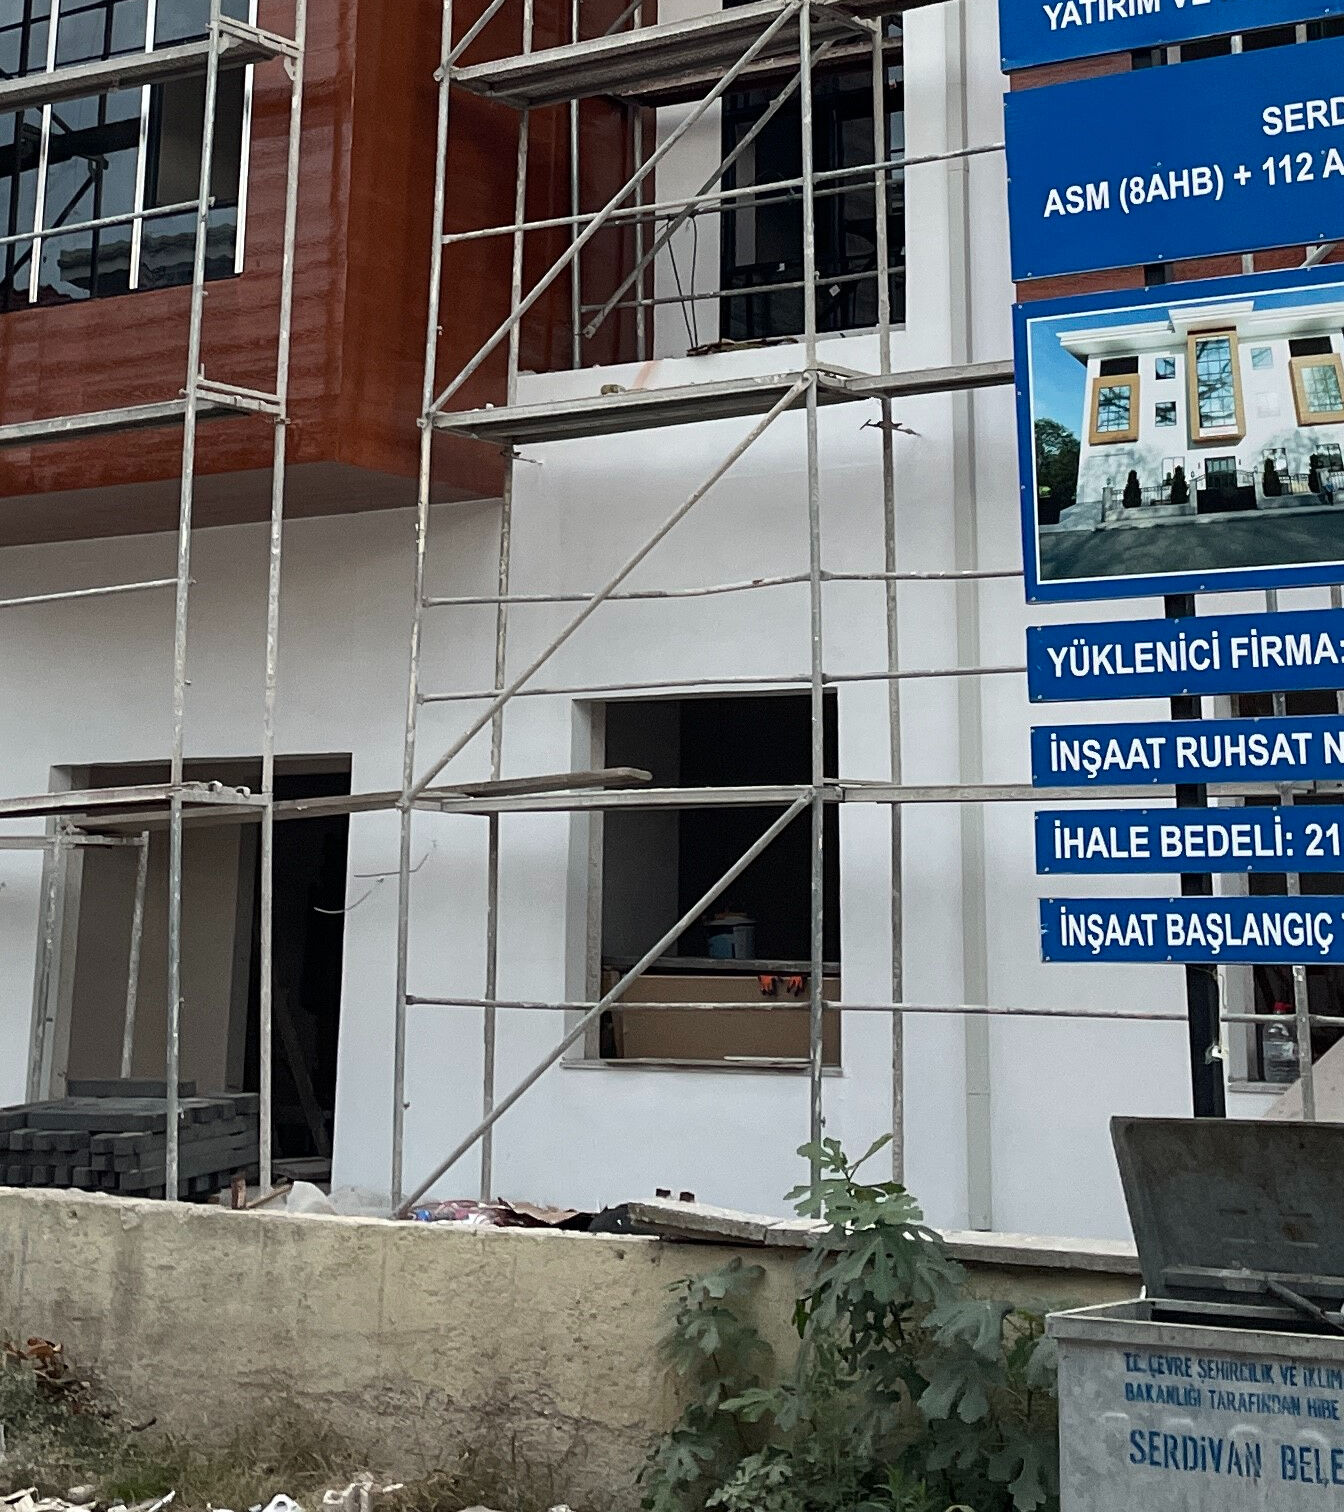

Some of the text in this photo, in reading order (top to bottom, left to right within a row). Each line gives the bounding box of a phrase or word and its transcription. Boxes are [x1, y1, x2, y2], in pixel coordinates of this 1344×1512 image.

[1043, 181, 1110, 218] ASM
[1119, 164, 1224, 214] (8AHB)
[1233, 165, 1252, 186] +
[1262, 152, 1314, 186] 112
[1046, 630, 1220, 678] YÜKLENİCİ
[1050, 732, 1166, 779] İNŞAAT
[1176, 732, 1313, 768] RUHSAT
[1054, 819, 1150, 859] İHALE
[1160, 815, 1294, 858] BEDELİ:
[1060, 906, 1158, 955] İNŞAAT
[1166, 912, 1334, 955] BAŞLANGIÇ
[1148, 1354, 1193, 1378] ÇEVRE
[1279, 1363, 1298, 1387] VE
[1207, 1389, 1301, 1417] TARAFINDAN
[1129, 1429, 1262, 1479] SERDİVAN
